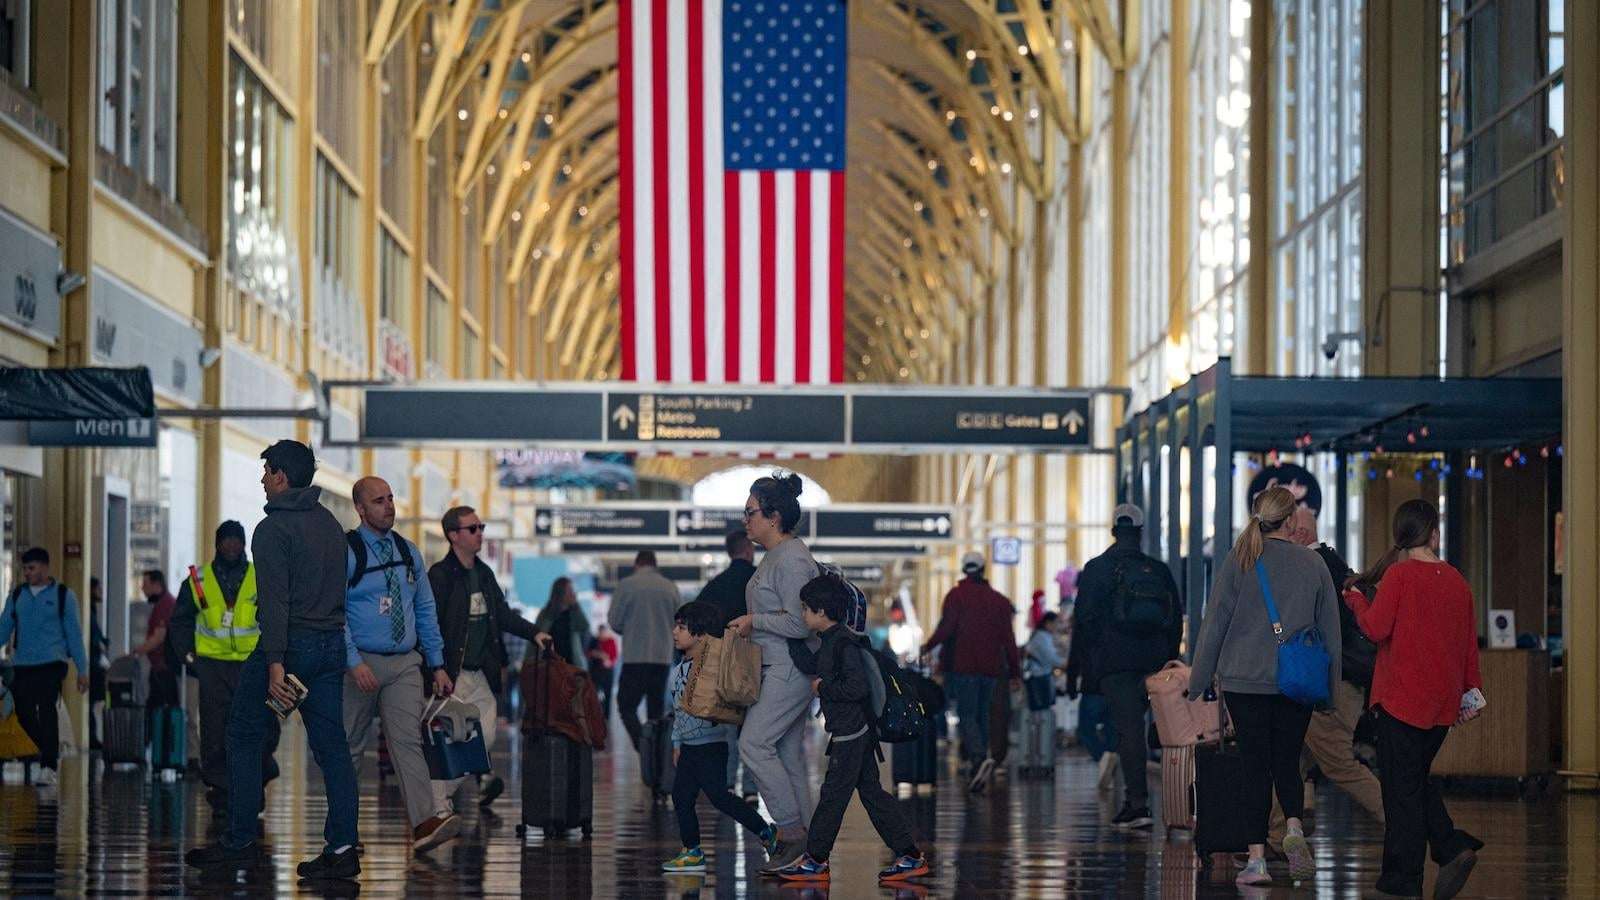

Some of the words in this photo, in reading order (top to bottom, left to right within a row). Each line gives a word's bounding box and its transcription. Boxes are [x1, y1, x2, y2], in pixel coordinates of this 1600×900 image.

[657, 396, 693, 409] South
[695, 396, 742, 412] Parking
[656, 411, 695, 423] Metro
[75, 419, 124, 436] Men
[656, 424, 720, 438] Restrooms
